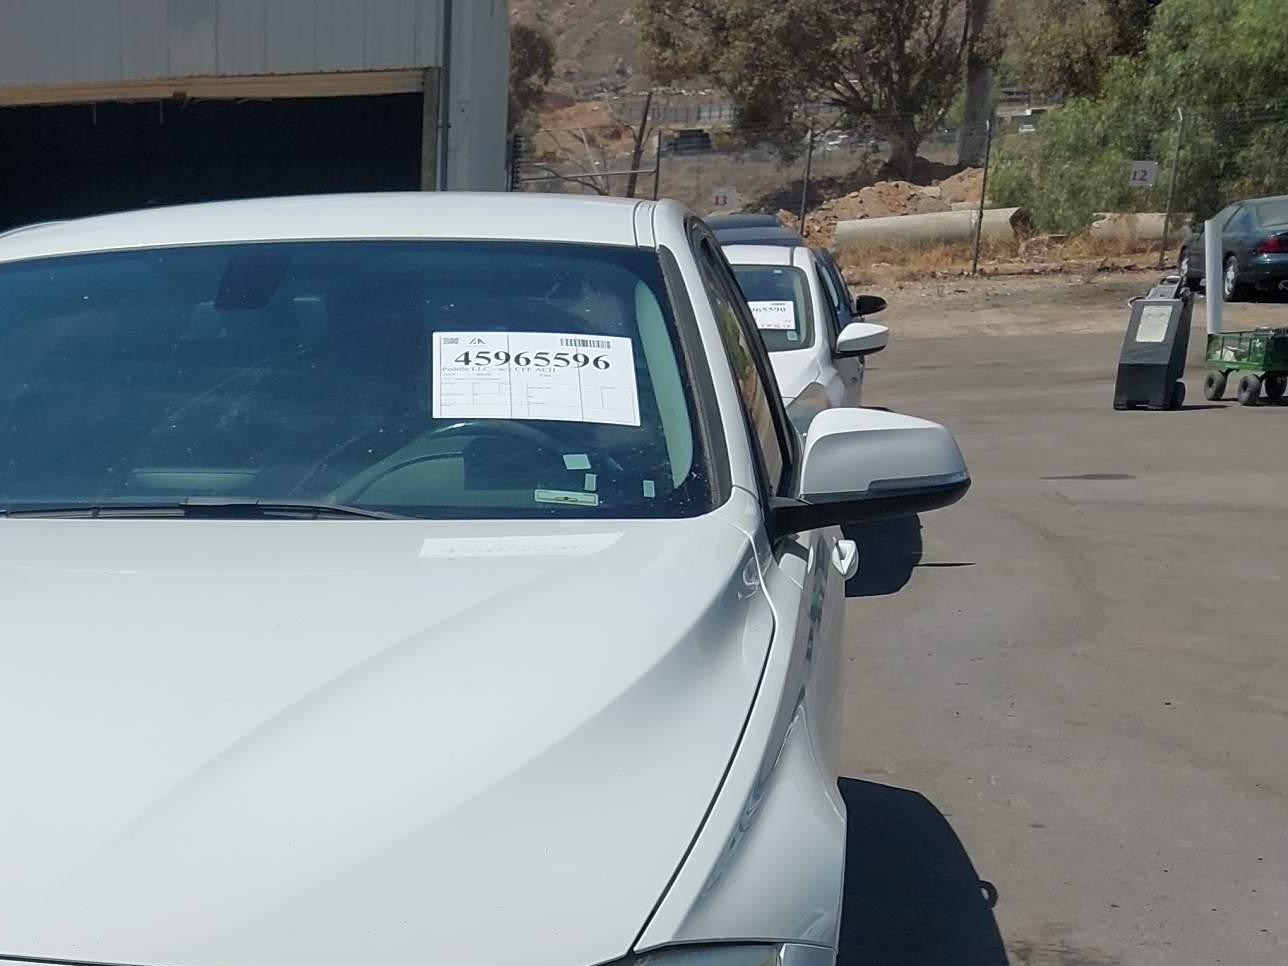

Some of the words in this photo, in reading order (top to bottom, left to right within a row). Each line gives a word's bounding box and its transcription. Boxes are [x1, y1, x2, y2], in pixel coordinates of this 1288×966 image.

[1132, 169, 1148, 181] 12
[715, 195, 727, 206] 13
[454, 351, 610, 370] 45965596
